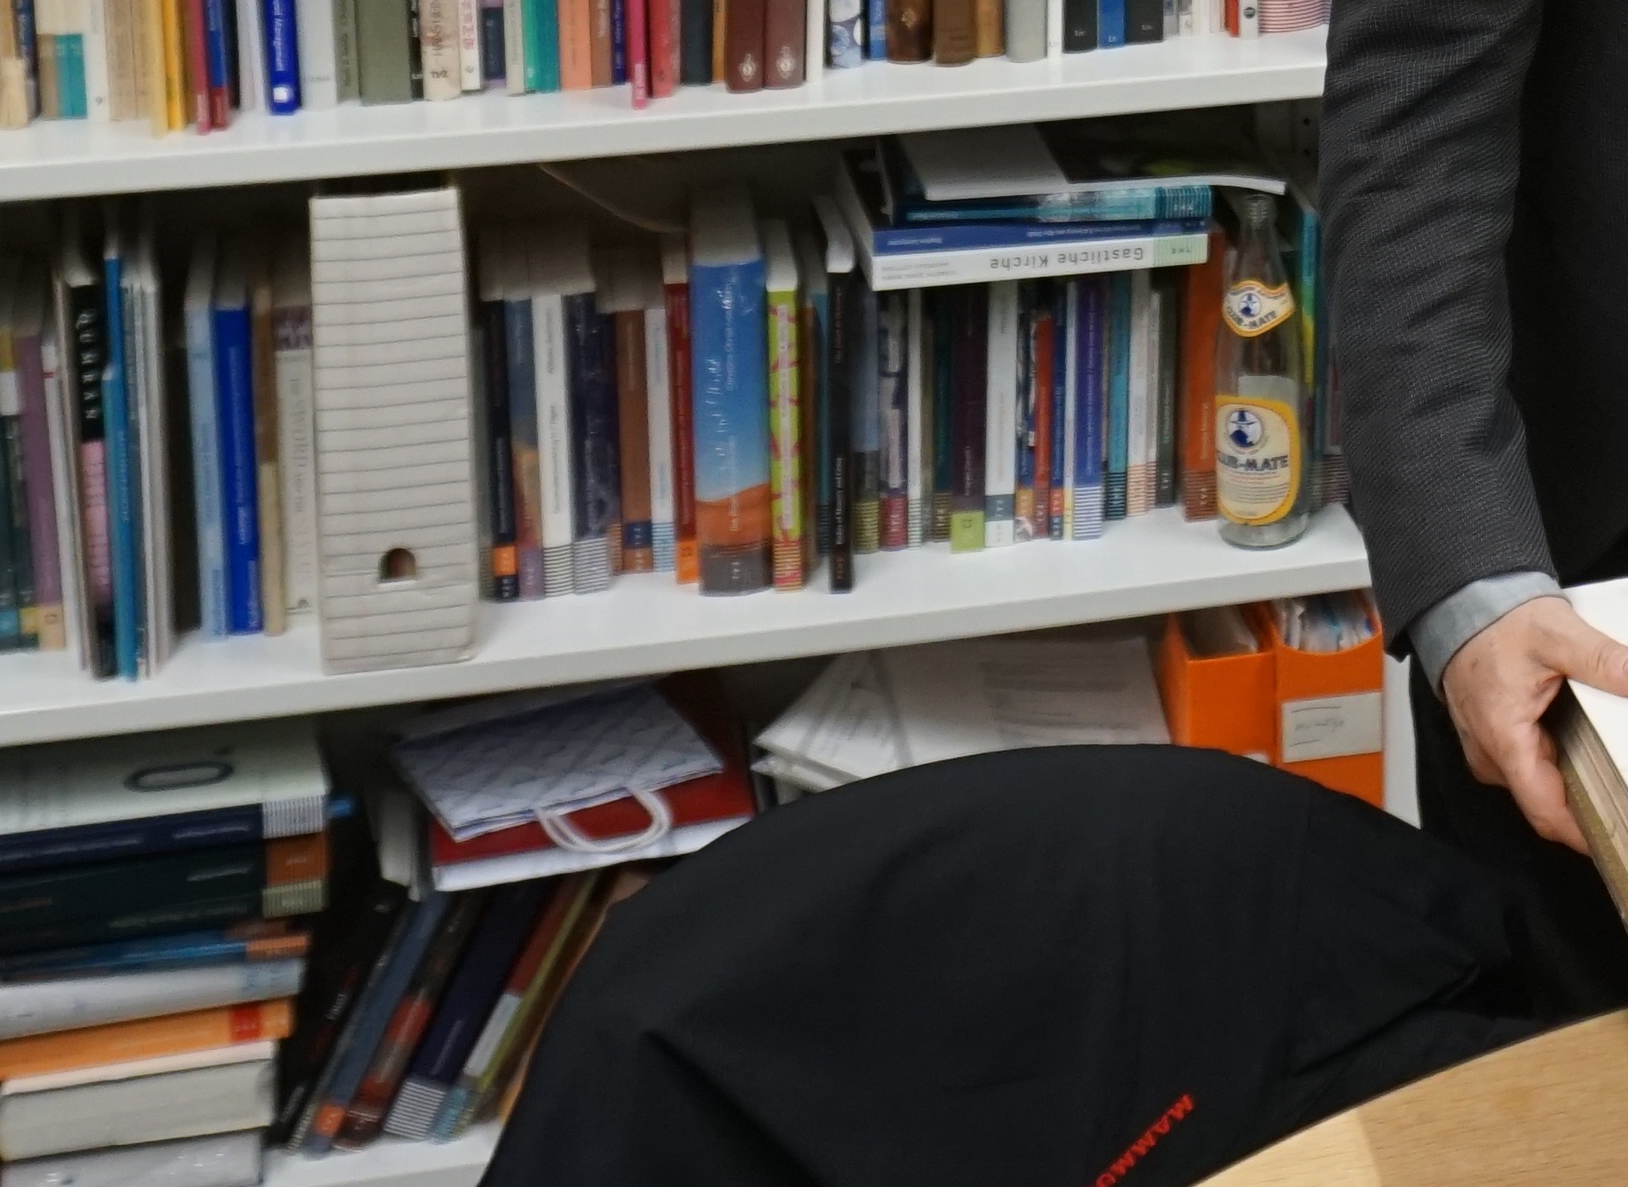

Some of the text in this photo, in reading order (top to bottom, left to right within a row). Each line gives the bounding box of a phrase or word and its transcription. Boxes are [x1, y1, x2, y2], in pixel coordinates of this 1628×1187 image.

[272, 17, 285, 72] Management
[989, 246, 1144, 272] Gastliche Kirche
